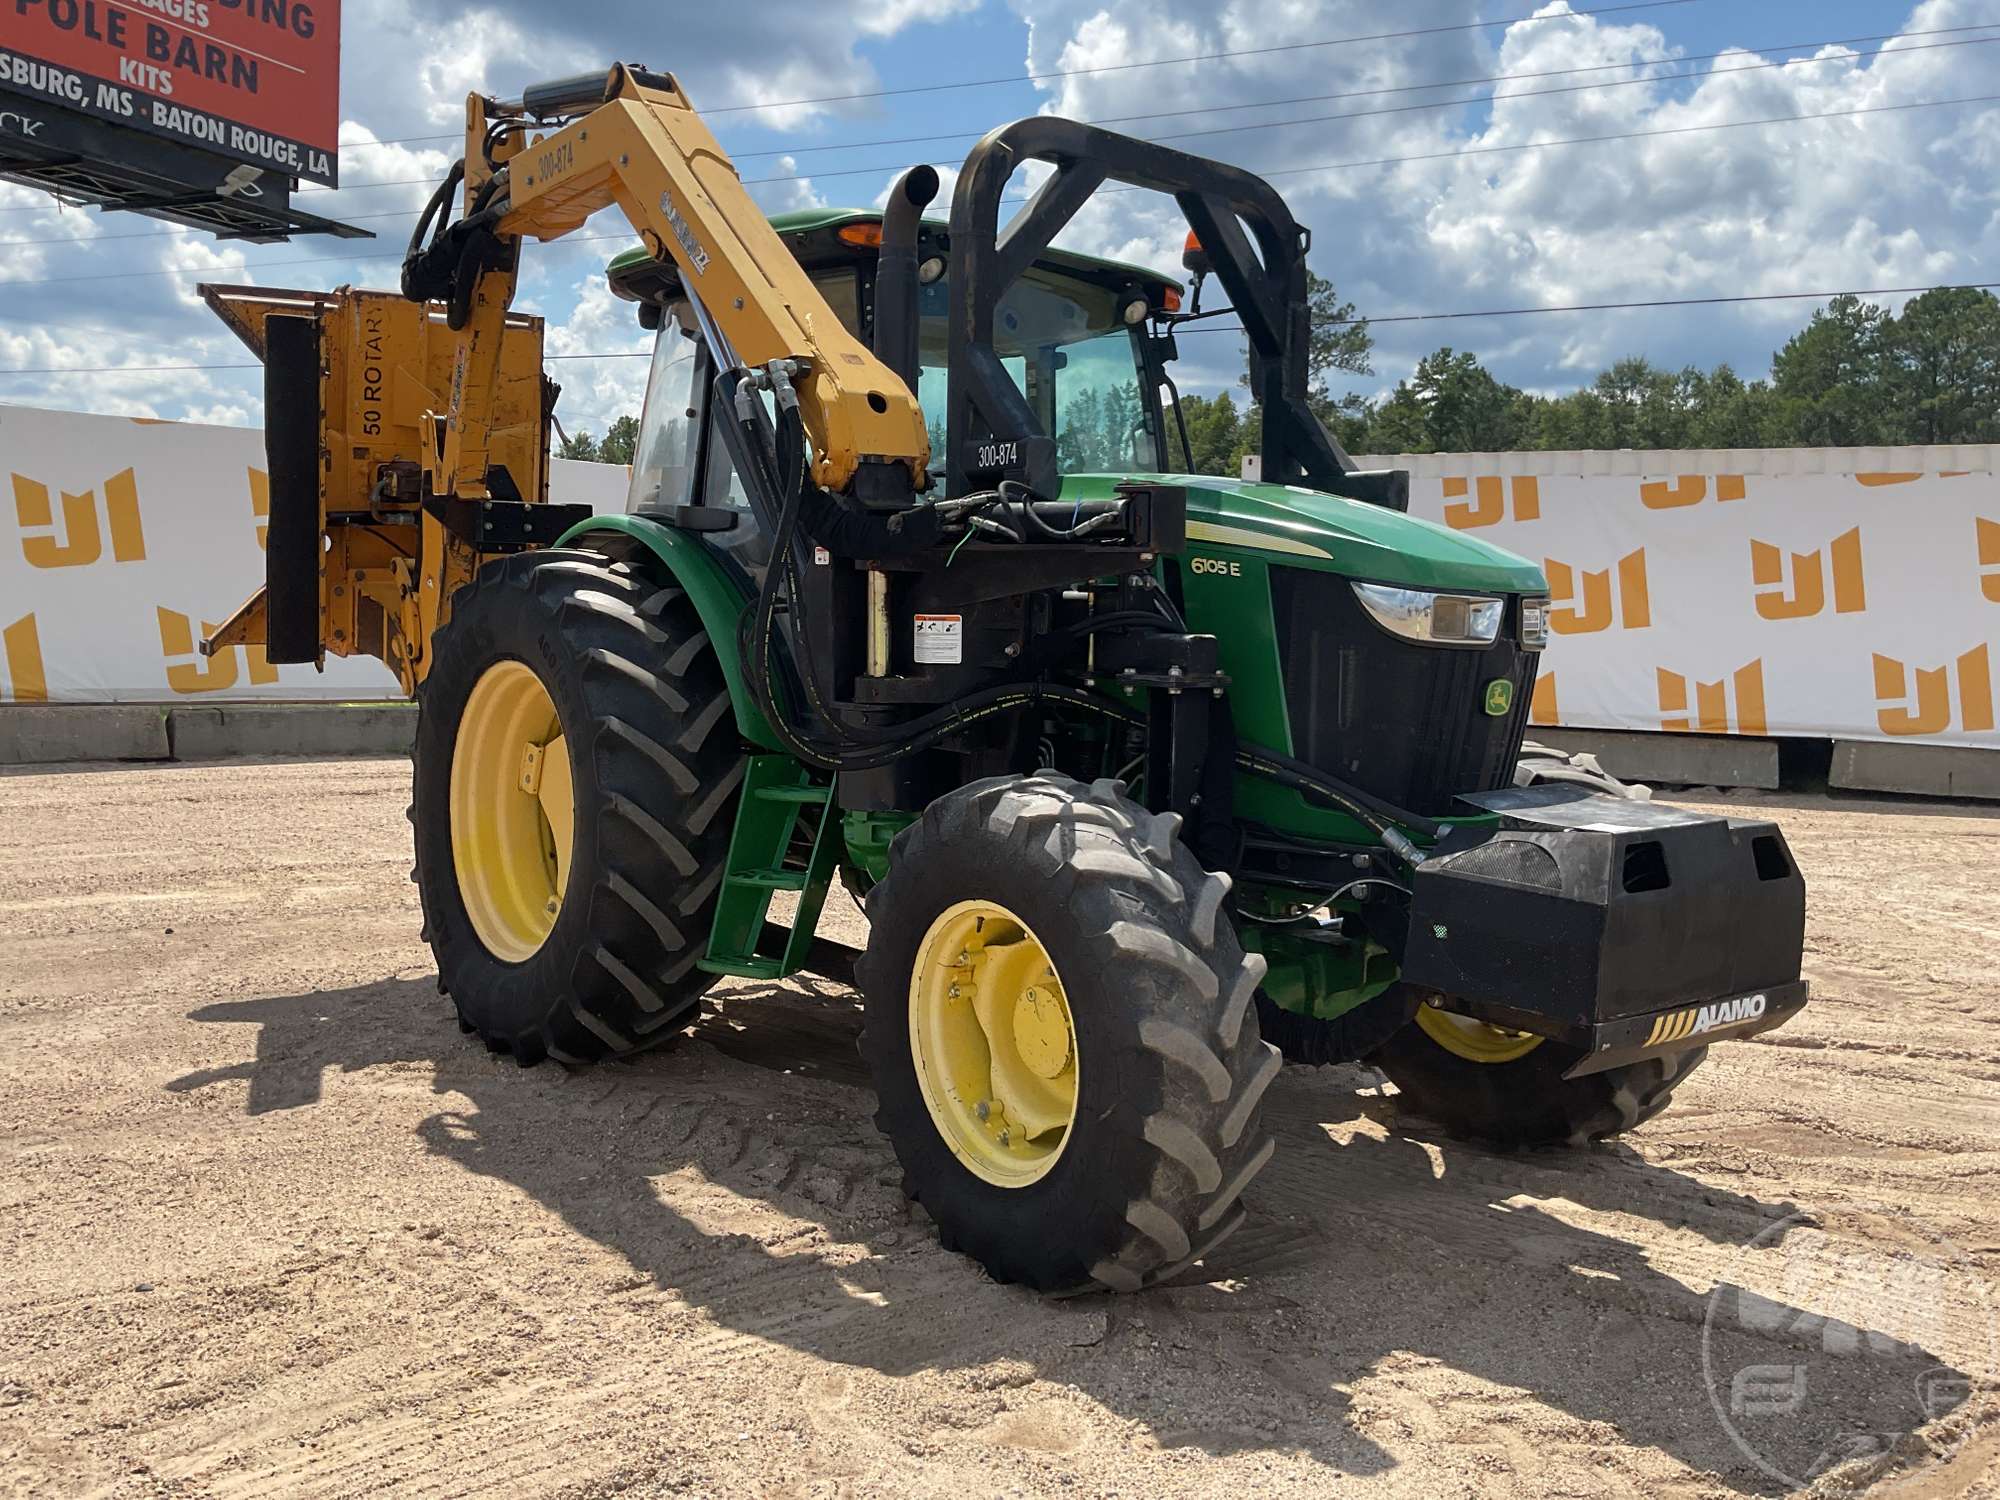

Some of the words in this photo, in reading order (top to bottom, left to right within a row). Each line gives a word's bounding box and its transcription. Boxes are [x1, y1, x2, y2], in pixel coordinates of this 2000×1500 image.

[119, 56, 174, 95] KITS
[146, 23, 258, 94] BARN
[96, 84, 134, 117] MS
[152, 101, 225, 145] BATON
[231, 126, 303, 171] ROUGE,
[308, 150, 331, 177] LA
[538, 140, 574, 182] 300-874
[363, 410, 381, 436] 50
[978, 442, 1018, 468] 300-874
[1191, 557, 1228, 575] 6105
[1686, 994, 1766, 1036] ALAMO
